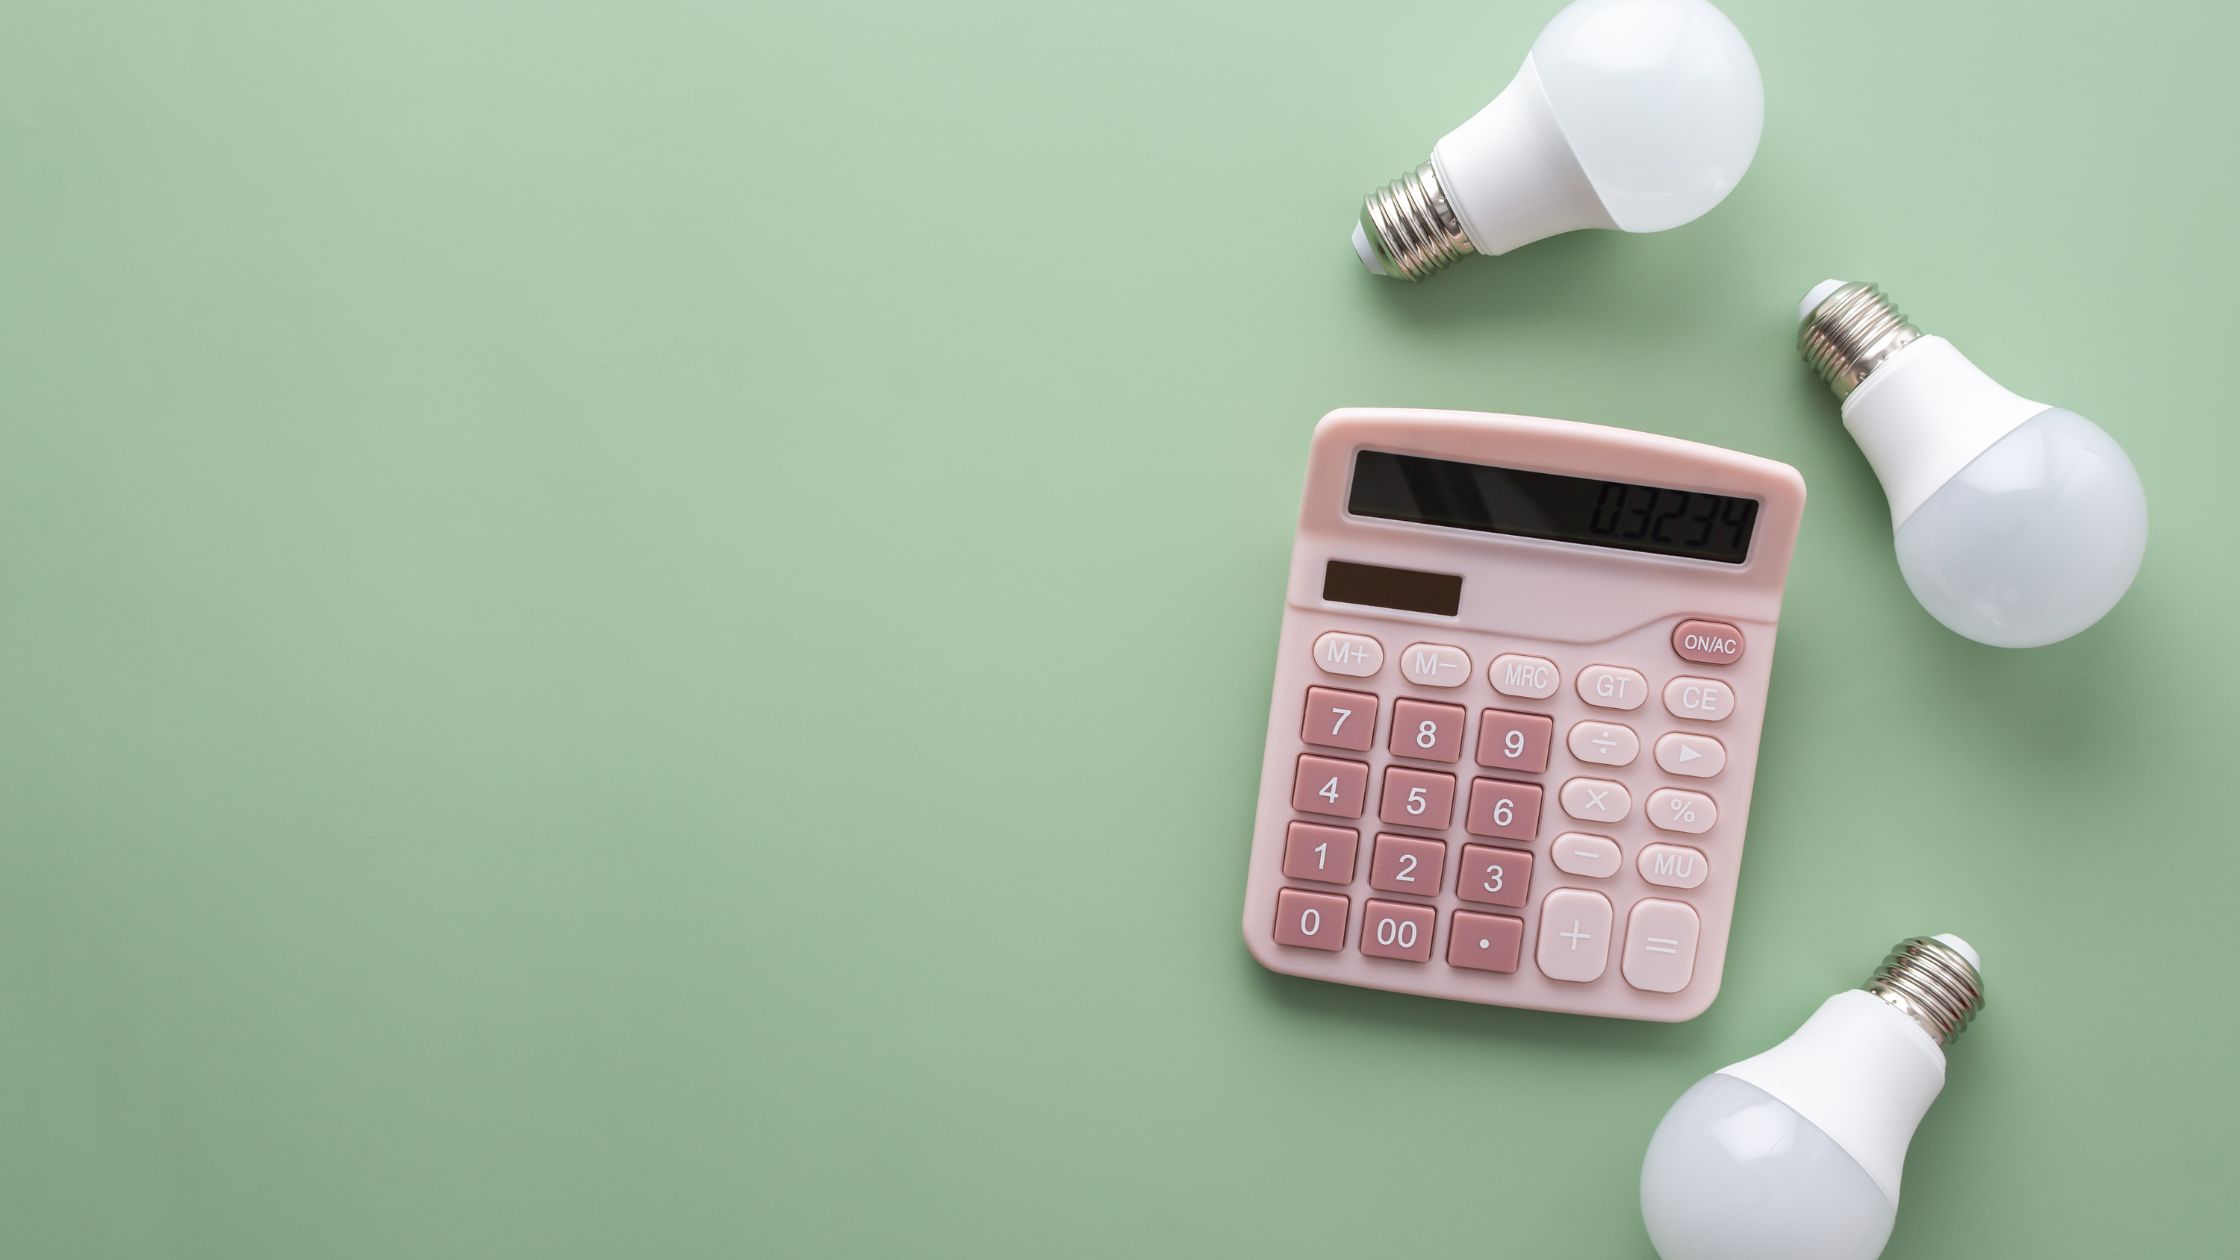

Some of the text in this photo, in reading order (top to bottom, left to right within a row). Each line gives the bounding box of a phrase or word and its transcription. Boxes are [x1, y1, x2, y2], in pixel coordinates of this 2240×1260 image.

[1327, 640, 1370, 665] M+
[1684, 634, 1736, 655] ON/AC
[1504, 663, 1549, 690] MRC
[1596, 674, 1631, 700] GT
[1682, 686, 1719, 711] CE
[1331, 707, 1352, 736] 7
[1416, 720, 1437, 749] 8
[1504, 730, 1525, 758] 9
[1318, 776, 1339, 804] 4
[1406, 787, 1427, 815] 5
[1493, 798, 1515, 827] 6
[1670, 798, 1696, 823] %
[1314, 842, 1328, 870] 1
[1395, 854, 1418, 882] 2
[1654, 852, 1695, 878] MU
[1483, 864, 1504, 893] 3
[1300, 908, 1321, 936] 0
[1376, 918, 1418, 948] 00
[1559, 919, 1591, 951] +
[1645, 936, 1679, 955] =
